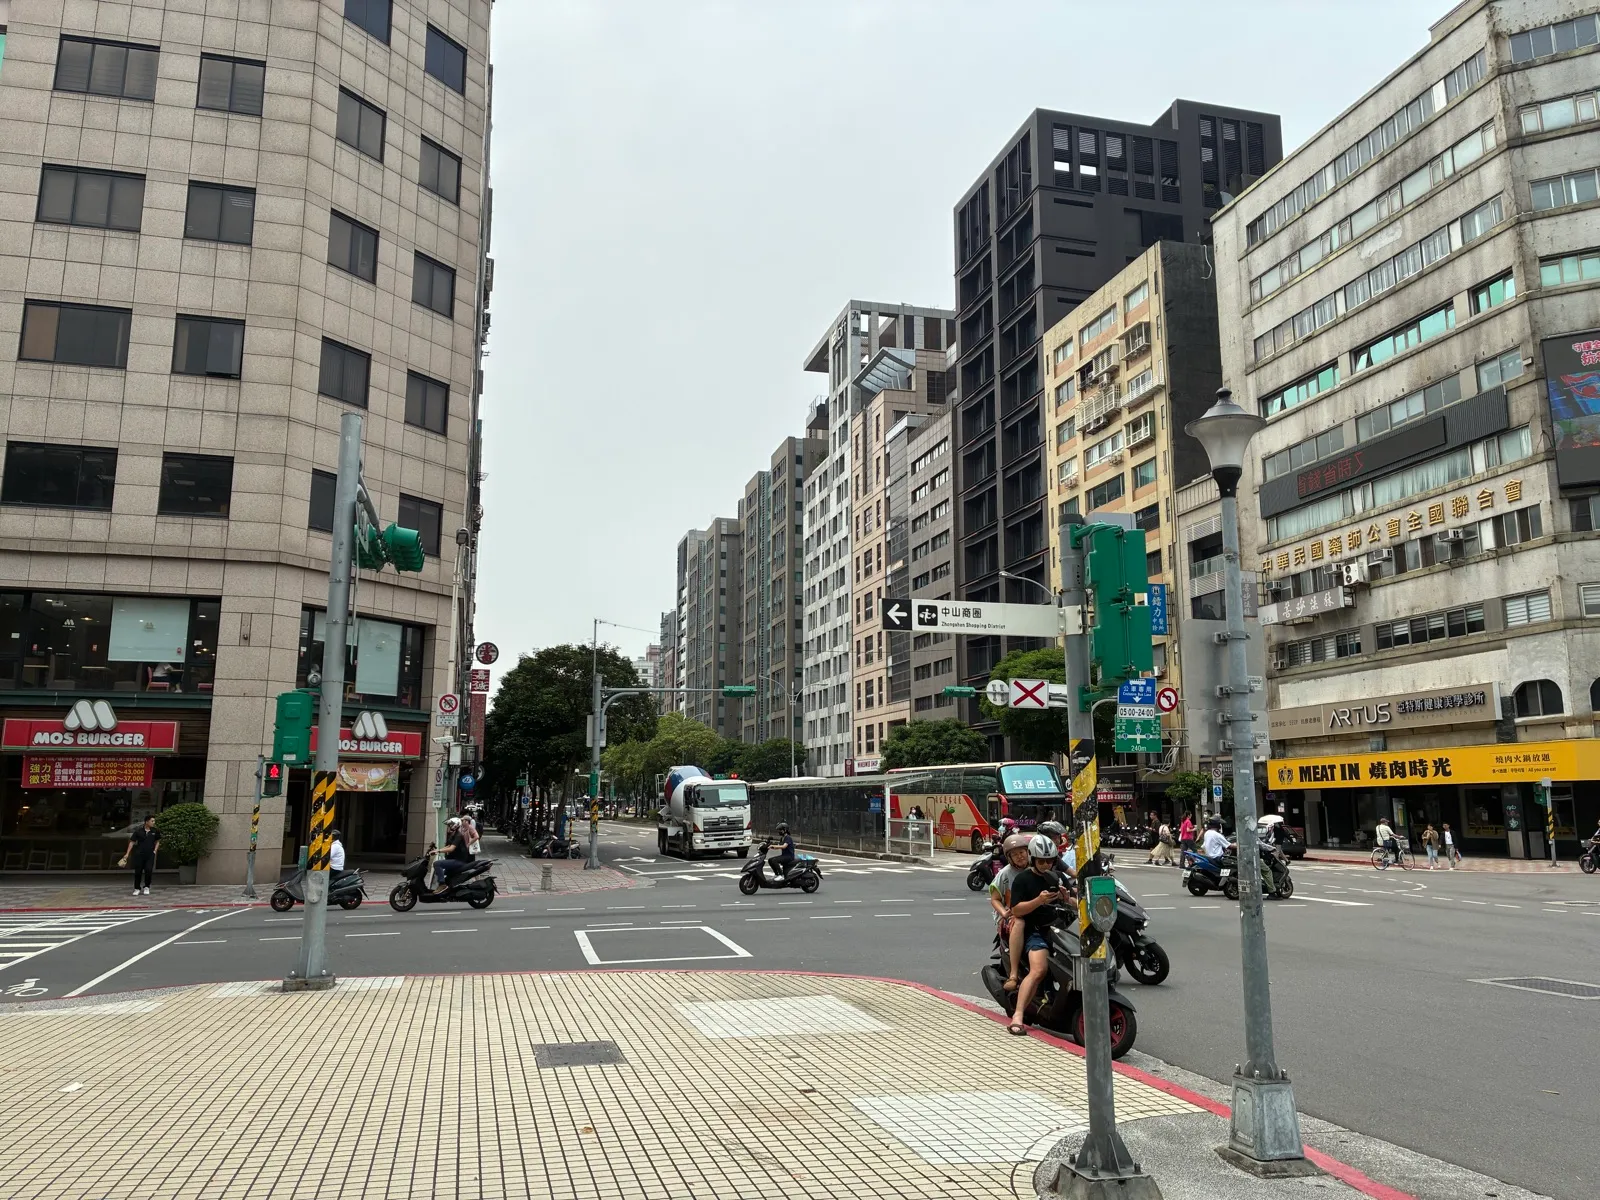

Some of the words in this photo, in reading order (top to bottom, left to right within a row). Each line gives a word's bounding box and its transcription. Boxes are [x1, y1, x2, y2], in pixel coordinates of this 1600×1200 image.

[1261, 479, 1523, 572] 中華民國藥師公會全國聯合會
[941, 606, 982, 619] 中山商圈
[966, 622, 987, 630] Shopping
[1123, 685, 1152, 693] 公車專用
[1119, 708, 1154, 717] 05:00-24:00
[1329, 702, 1391, 728] ARTUS
[33, 732, 74, 745] MOS
[77, 732, 145, 746] BURGER
[339, 740, 357, 751] OS
[359, 741, 402, 753] BURGER
[1495, 753, 1550, 764] 燒肉火鍋放題
[29, 763, 52, 773] 強力
[1299, 764, 1336, 782] MEAT
[1340, 763, 1360, 781] IN
[1369, 757, 1452, 780] 燒肉時光
[29, 773, 51, 784] 徵求
[1012, 780, 1057, 790] 亞通巴士
